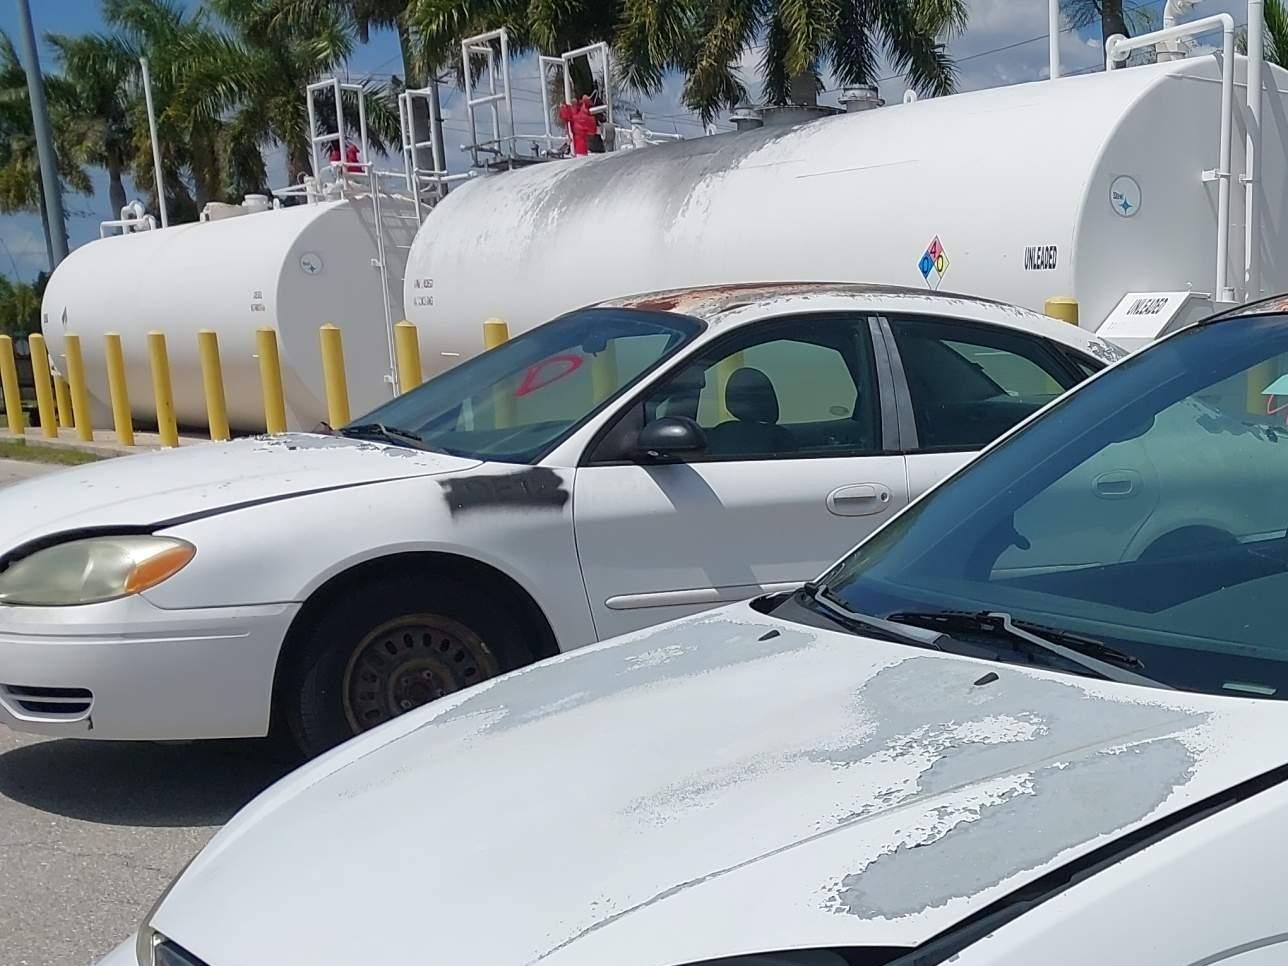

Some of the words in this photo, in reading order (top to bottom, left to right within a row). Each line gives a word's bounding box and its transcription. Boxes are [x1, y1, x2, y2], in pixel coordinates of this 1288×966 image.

[930, 240, 937, 259] 4
[1024, 245, 1058, 270] UNLEADED
[922, 256, 930, 274] 0
[936, 254, 944, 273] 0
[1126, 297, 1169, 316] UNLEADED
[514, 353, 584, 398] D
